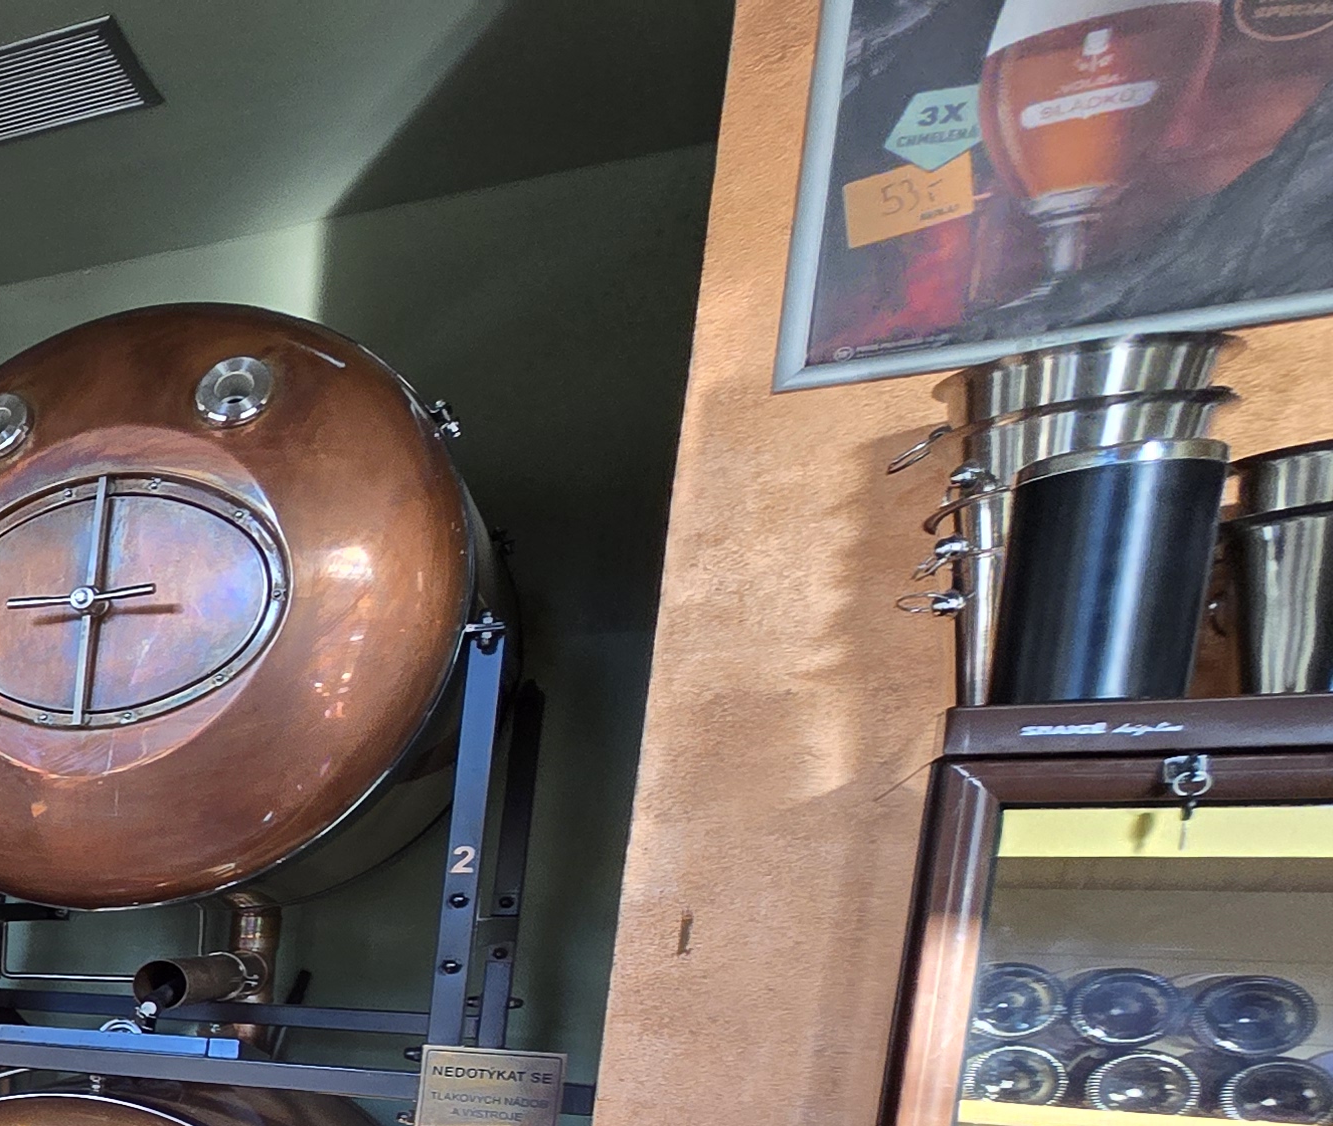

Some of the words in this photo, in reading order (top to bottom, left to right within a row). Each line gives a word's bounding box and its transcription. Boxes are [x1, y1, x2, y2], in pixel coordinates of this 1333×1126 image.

[917, 101, 968, 127] 3X
[450, 846, 476, 874] 2
[432, 1065, 527, 1082] NEDOTÝKAT
[530, 1072, 553, 1084] SE
[504, 1096, 549, 1109] NÁDOB
[451, 1107, 460, 1116] A
[462, 1107, 524, 1122] VÝSTROJE
